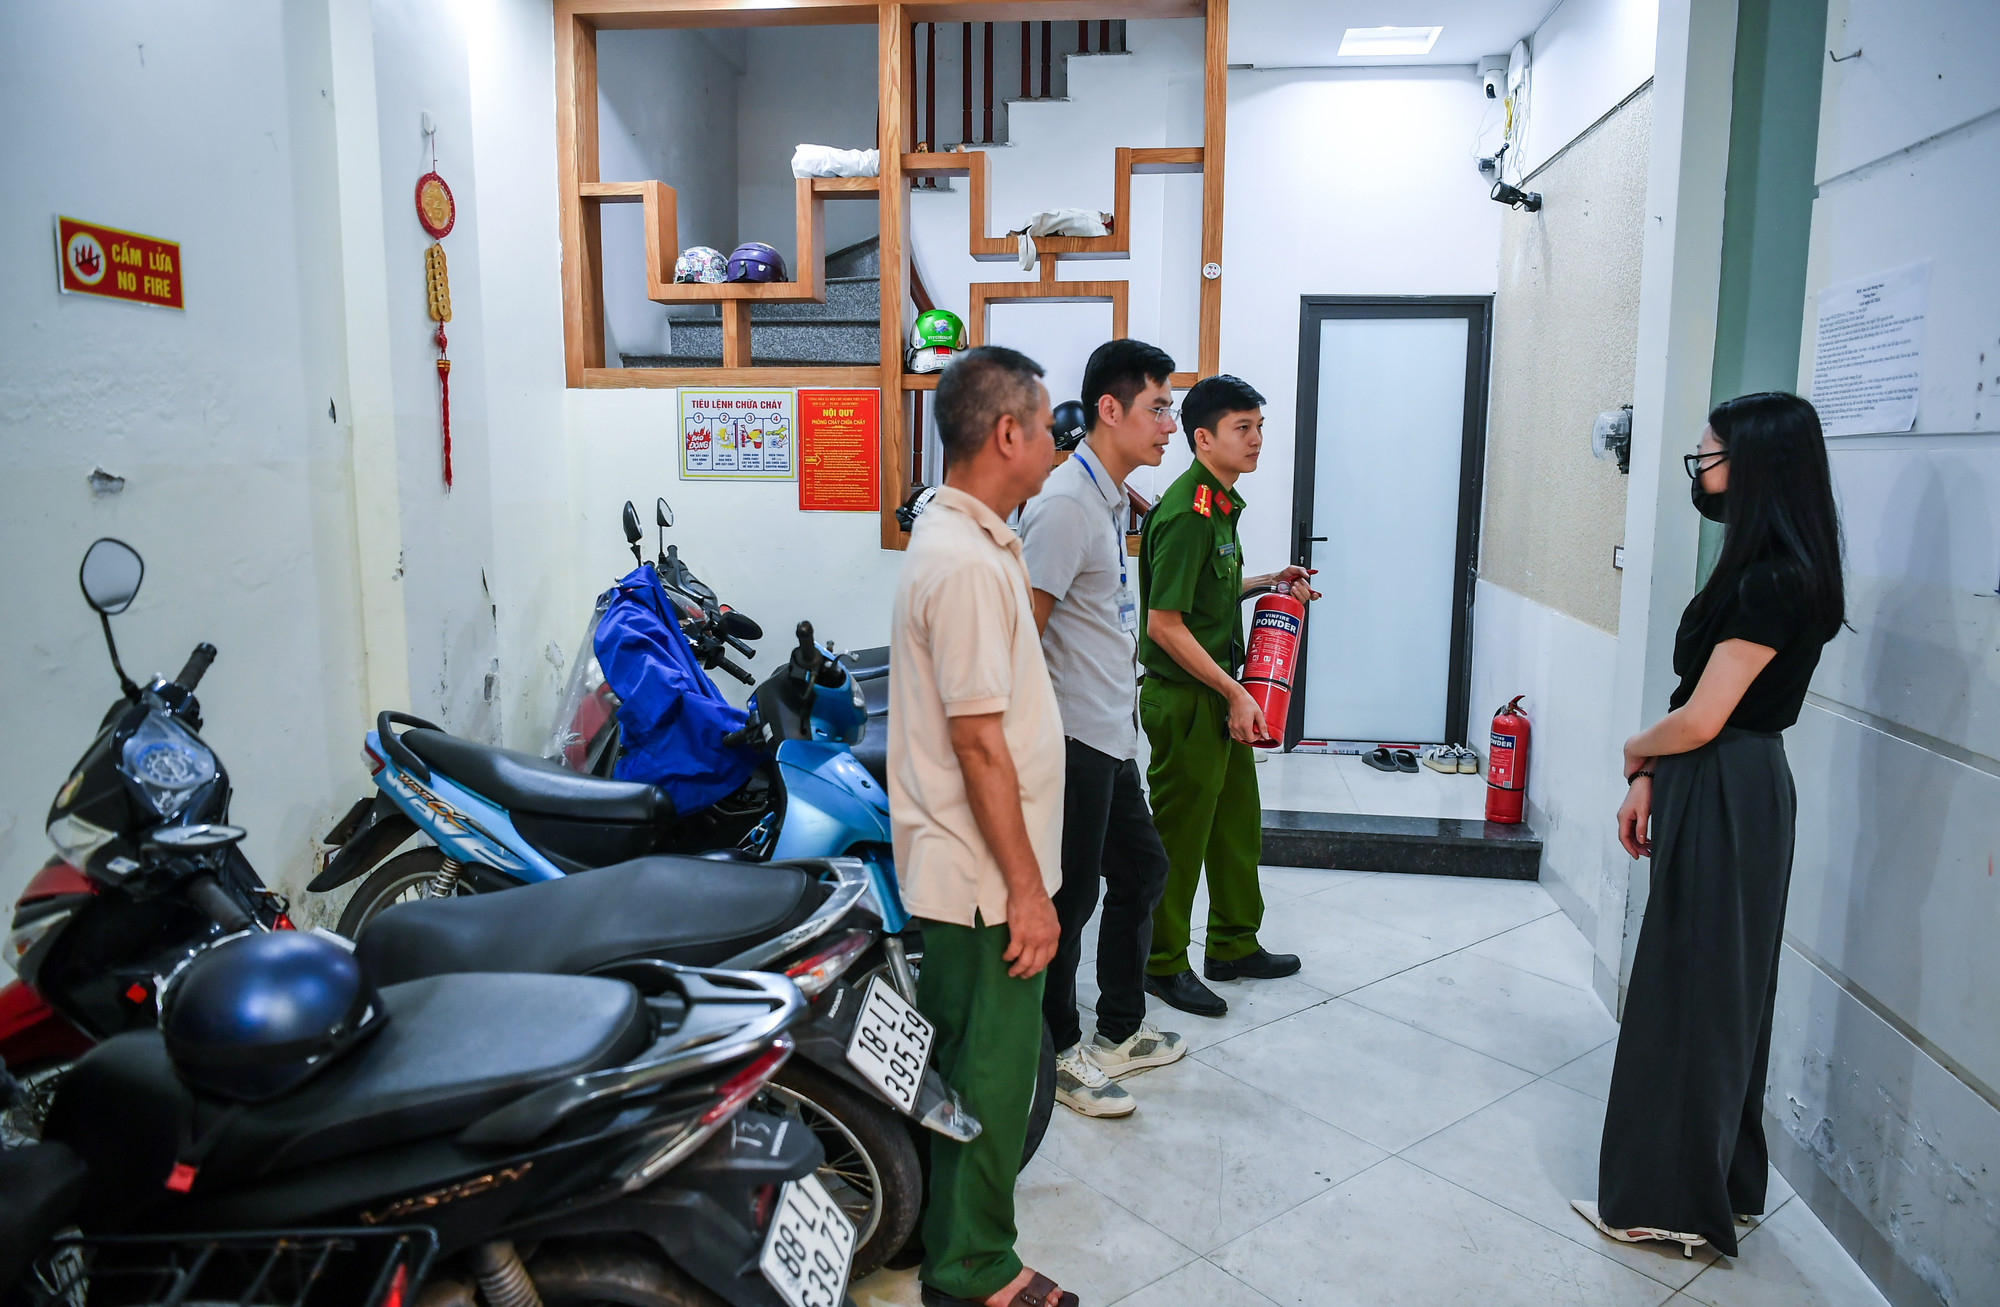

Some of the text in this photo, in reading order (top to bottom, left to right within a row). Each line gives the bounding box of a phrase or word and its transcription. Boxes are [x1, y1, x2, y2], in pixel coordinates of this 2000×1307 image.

[111, 240, 173, 273] CẤM LỬA
[117, 270, 171, 298] NO FIRE
[712, 398, 733, 410] LỆNH
[822, 407, 854, 418] NỘI QUY
[1255, 618, 1297, 634] POWDER
[1265, 613, 1290, 622] VINFIRE
[858, 991, 900, 1063] 18-L1
[884, 1010, 929, 1102] 395.59
[774, 1180, 820, 1279] 88-L1
